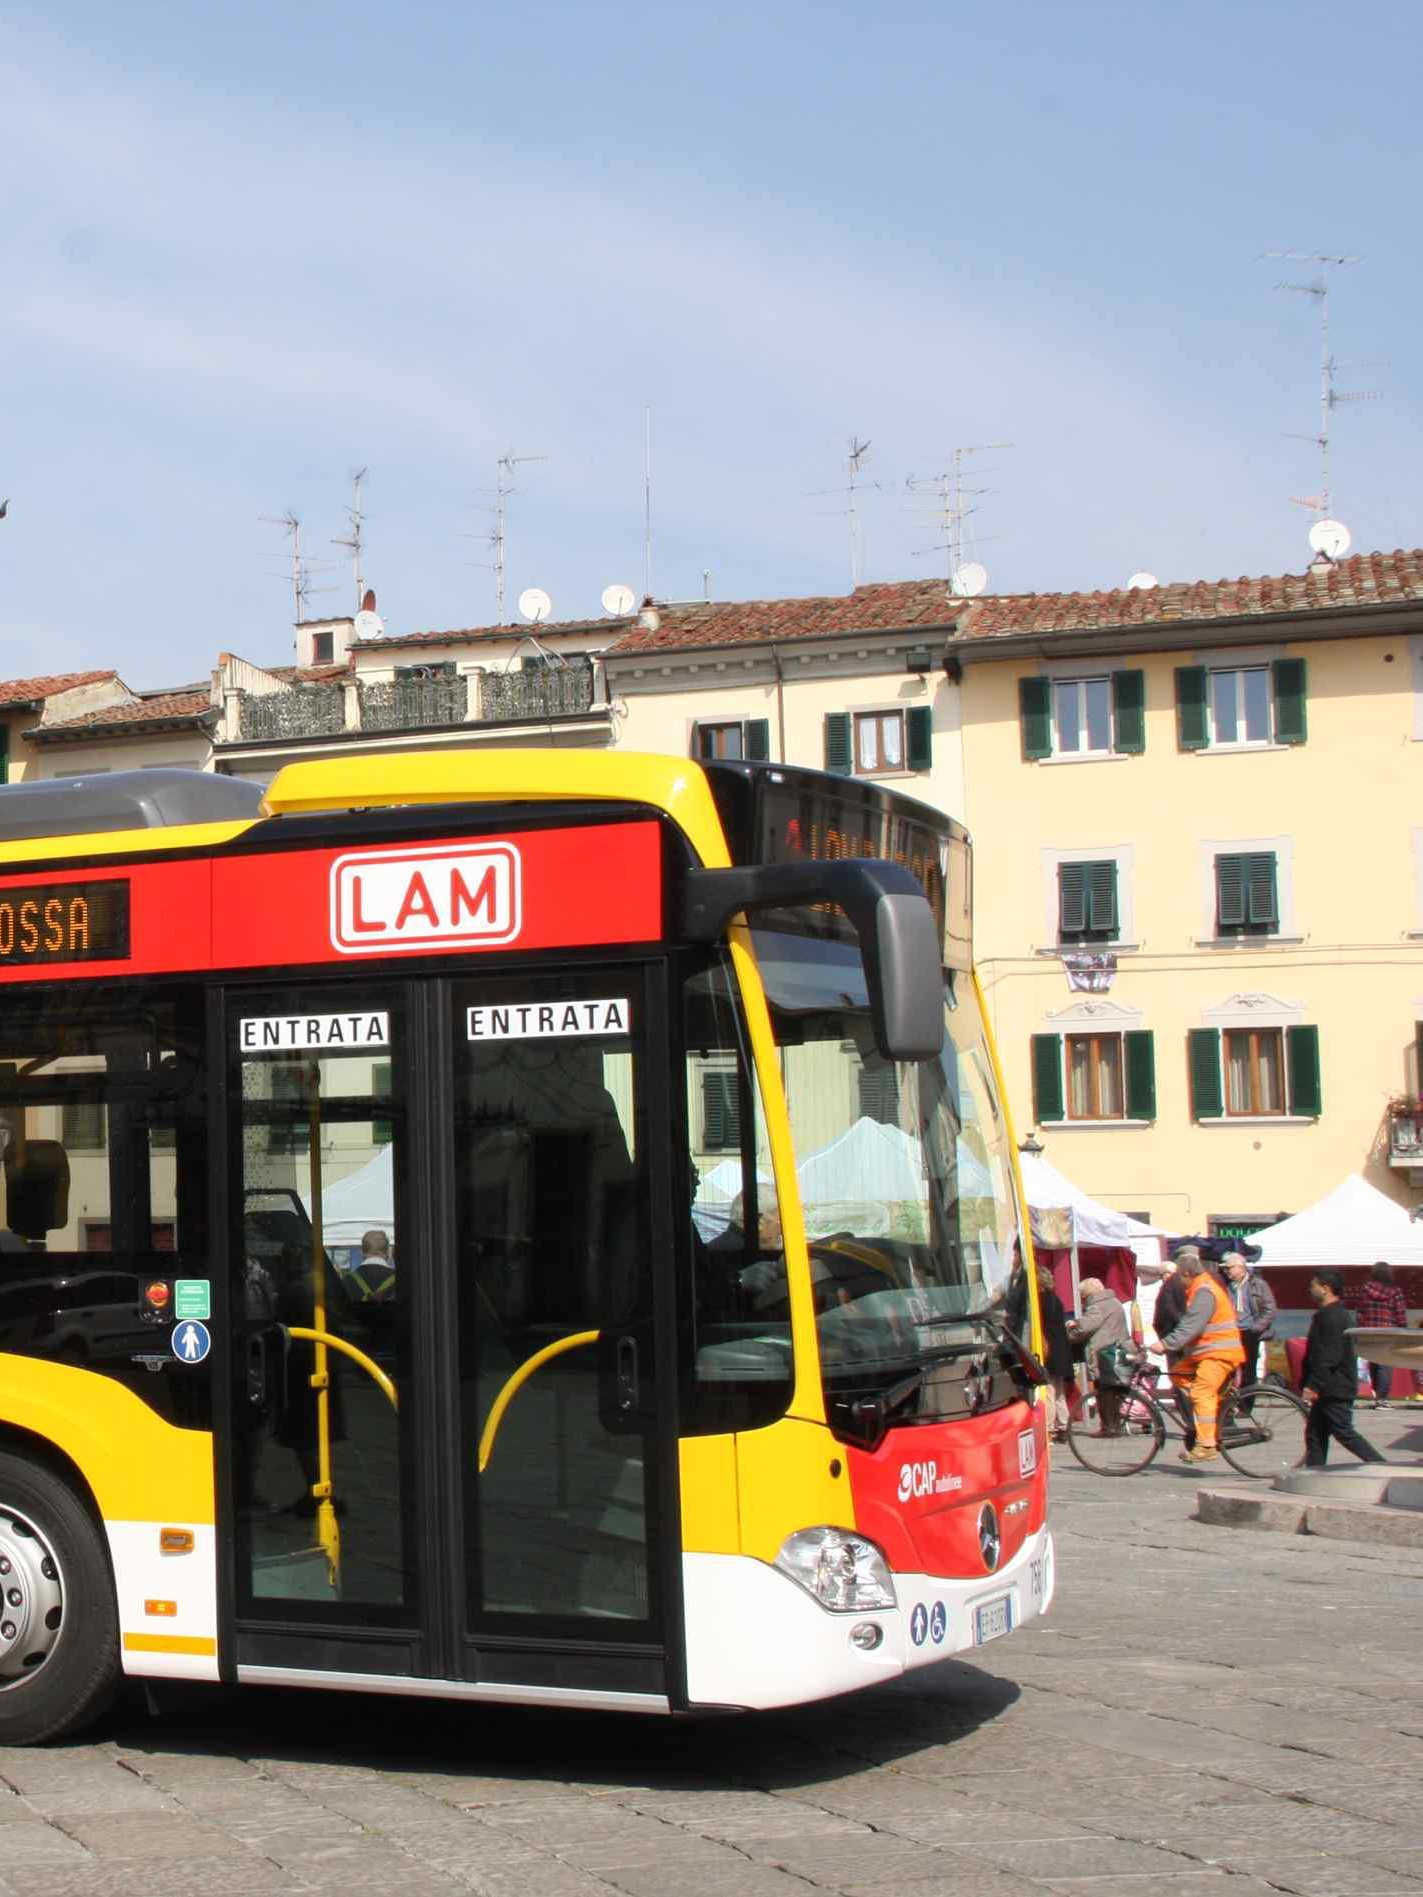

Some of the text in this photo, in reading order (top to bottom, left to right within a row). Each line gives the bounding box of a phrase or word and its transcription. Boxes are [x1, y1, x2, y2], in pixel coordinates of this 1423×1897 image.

[353, 865, 497, 933] LAM
[243, 1015, 386, 1048] ENTRATA
[470, 1002, 624, 1037] ENTRATA
[912, 1460, 937, 1497] CAP
